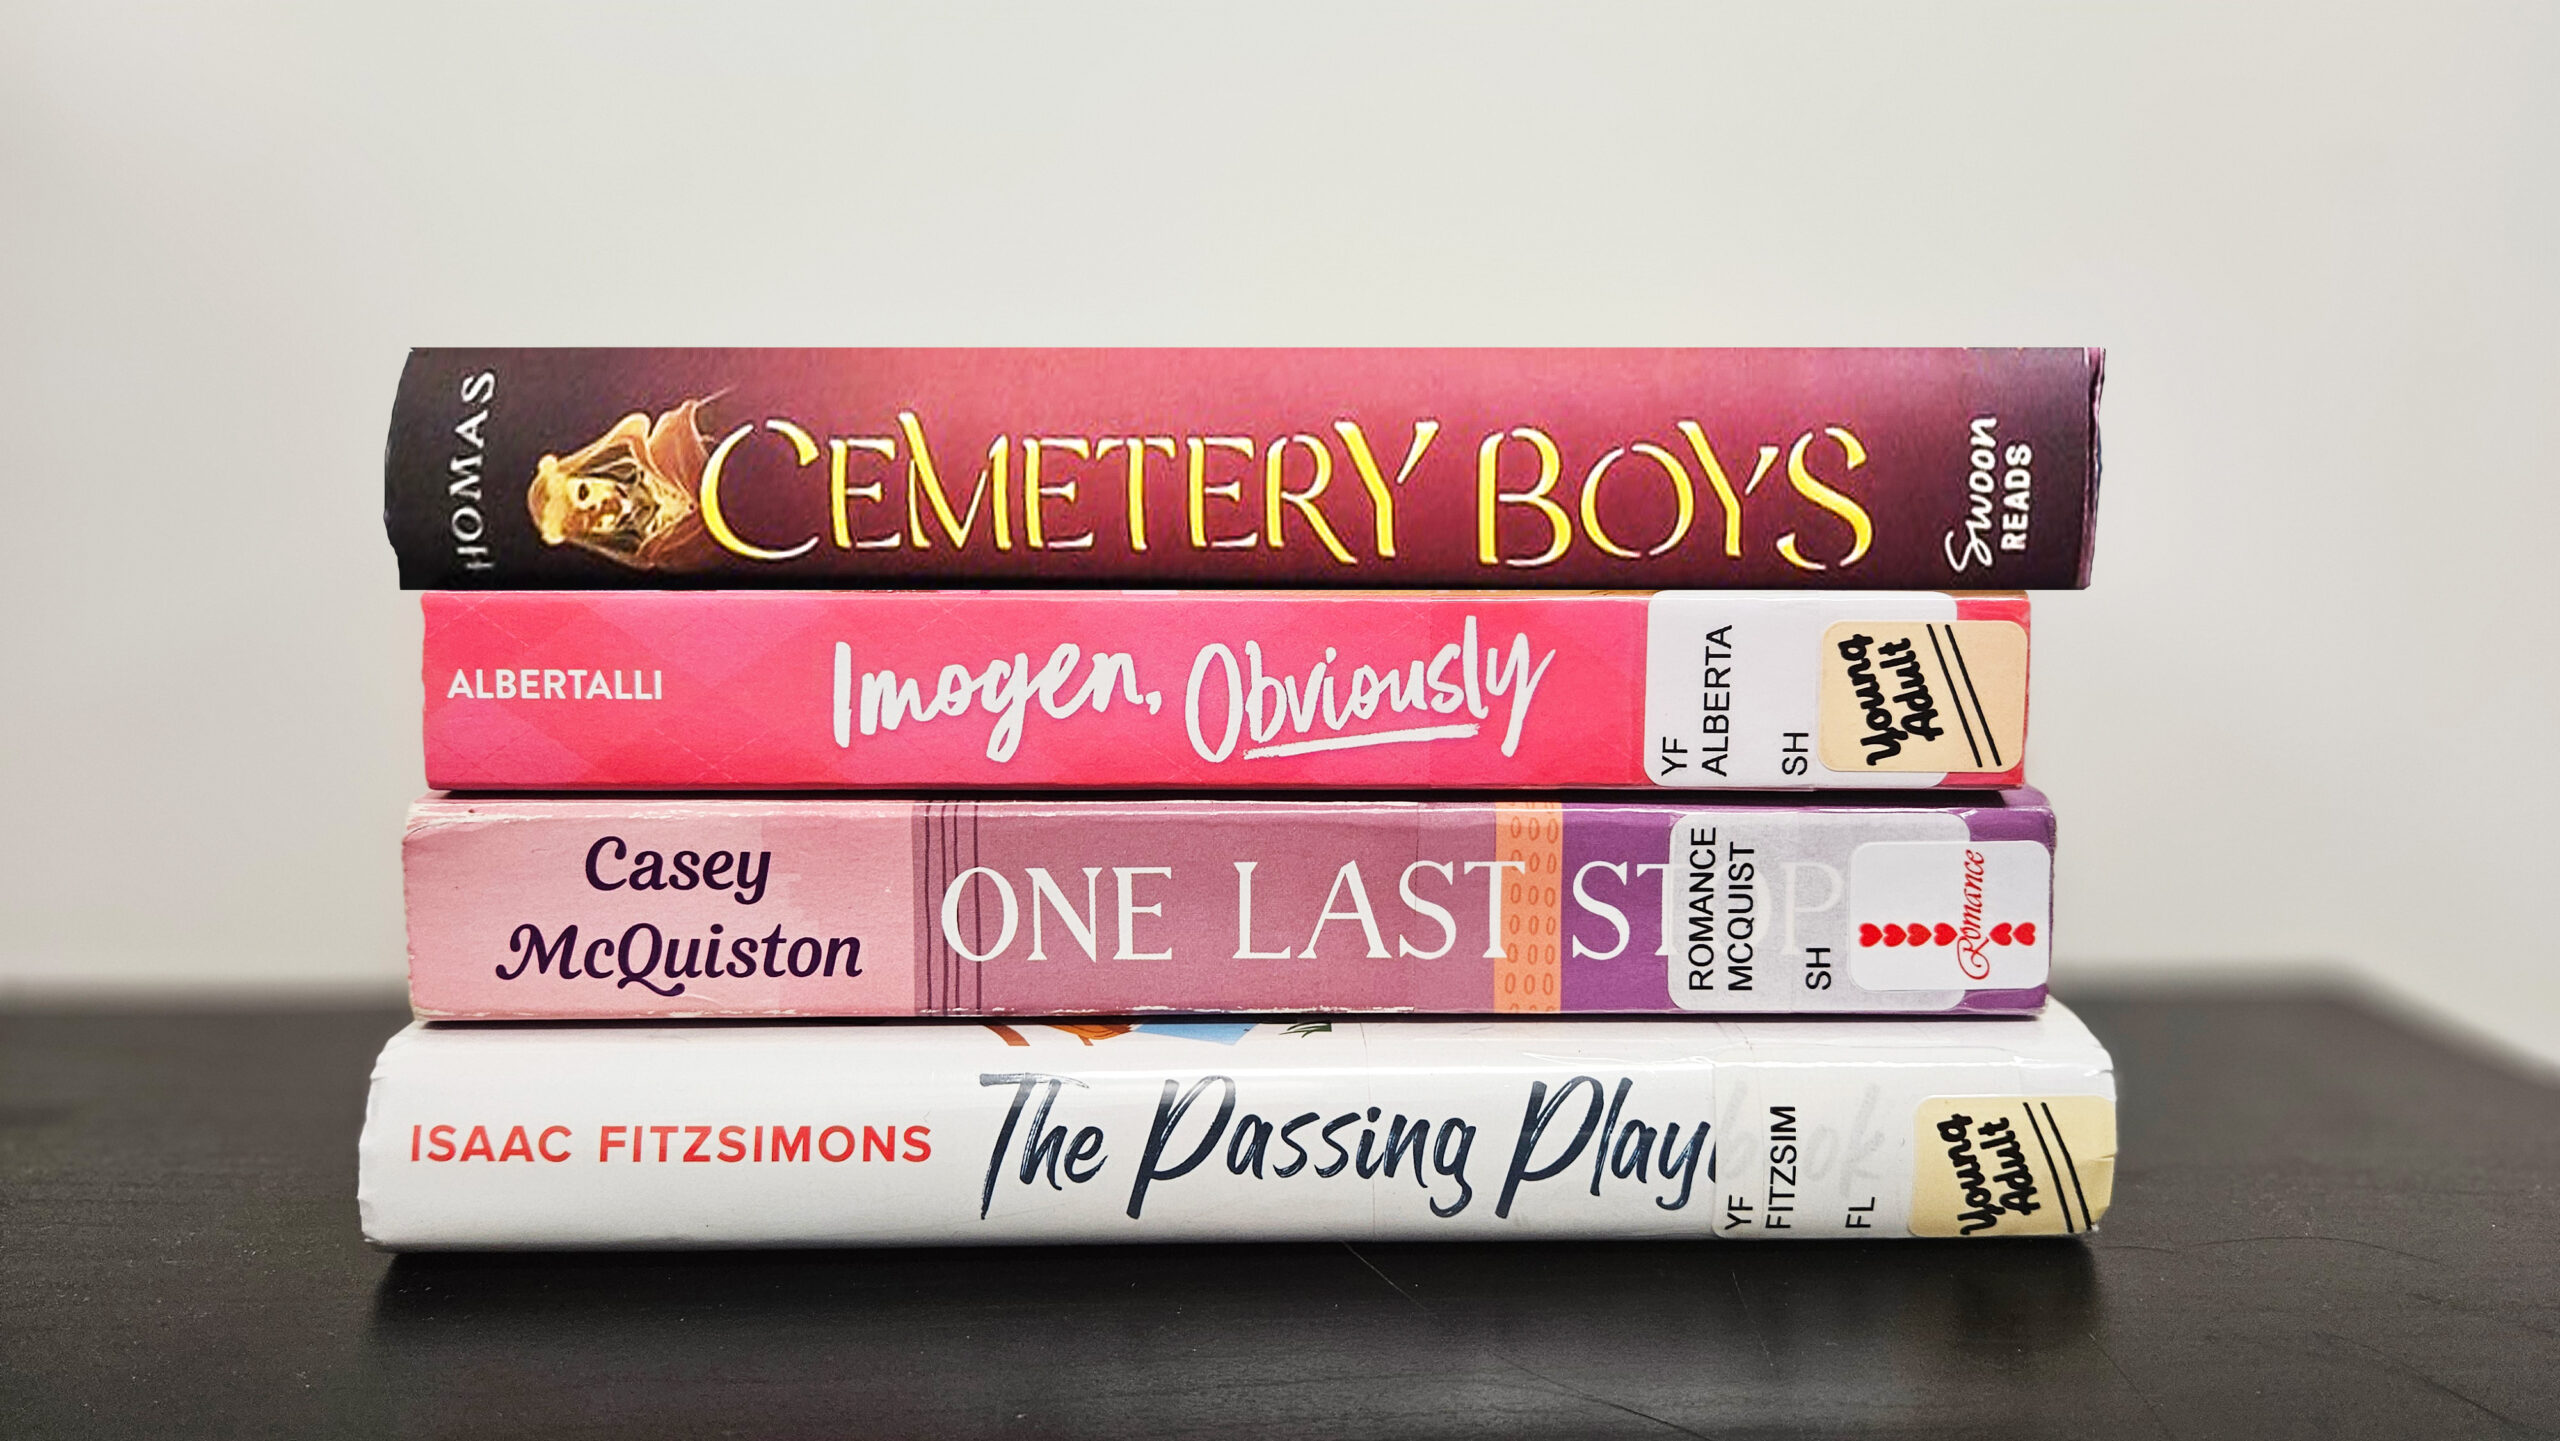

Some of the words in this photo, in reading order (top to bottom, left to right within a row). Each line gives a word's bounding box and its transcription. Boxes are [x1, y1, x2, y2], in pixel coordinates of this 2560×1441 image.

[698, 410, 1440, 565] CEMETERY
[1477, 420, 1873, 571] BOYS
[1945, 417, 1998, 572] Swoon
[2001, 443, 2033, 550] READS
[447, 668, 664, 701] ALBERTALLI
[833, 641, 1163, 763] Imogen,
[1185, 614, 1556, 764] Obviously
[1701, 624, 1733, 777] ALBERTA
[1838, 634, 1909, 766] Young
[1878, 638, 1944, 741] Adult
[1661, 736, 1689, 777] YF
[1781, 731, 1810, 776] SH
[585, 835, 771, 905] Casey
[941, 866, 1173, 962] ONE
[1232, 860, 1526, 960] LAST
[1689, 827, 1717, 991] ROMANCE
[1728, 842, 1755, 991] MCQUIST
[1956, 849, 1990, 980] Romance
[496, 922, 863, 997] McQuiston
[1806, 946, 1832, 991] SH
[410, 1125, 572, 1163] ISAAC
[599, 1125, 932, 1163] FITZSIMONS
[979, 1072, 1107, 1220] The
[1126, 1075, 1476, 1219] Passing
[1495, 1075, 1886, 1219] Playbok
[1765, 1105, 1797, 1229] FITZSIM
[1937, 1113, 2006, 1235] Young
[1978, 1117, 2041, 1215] Adult
[1725, 1194, 1754, 1230] YF
[1845, 1196, 1876, 1229] FL
